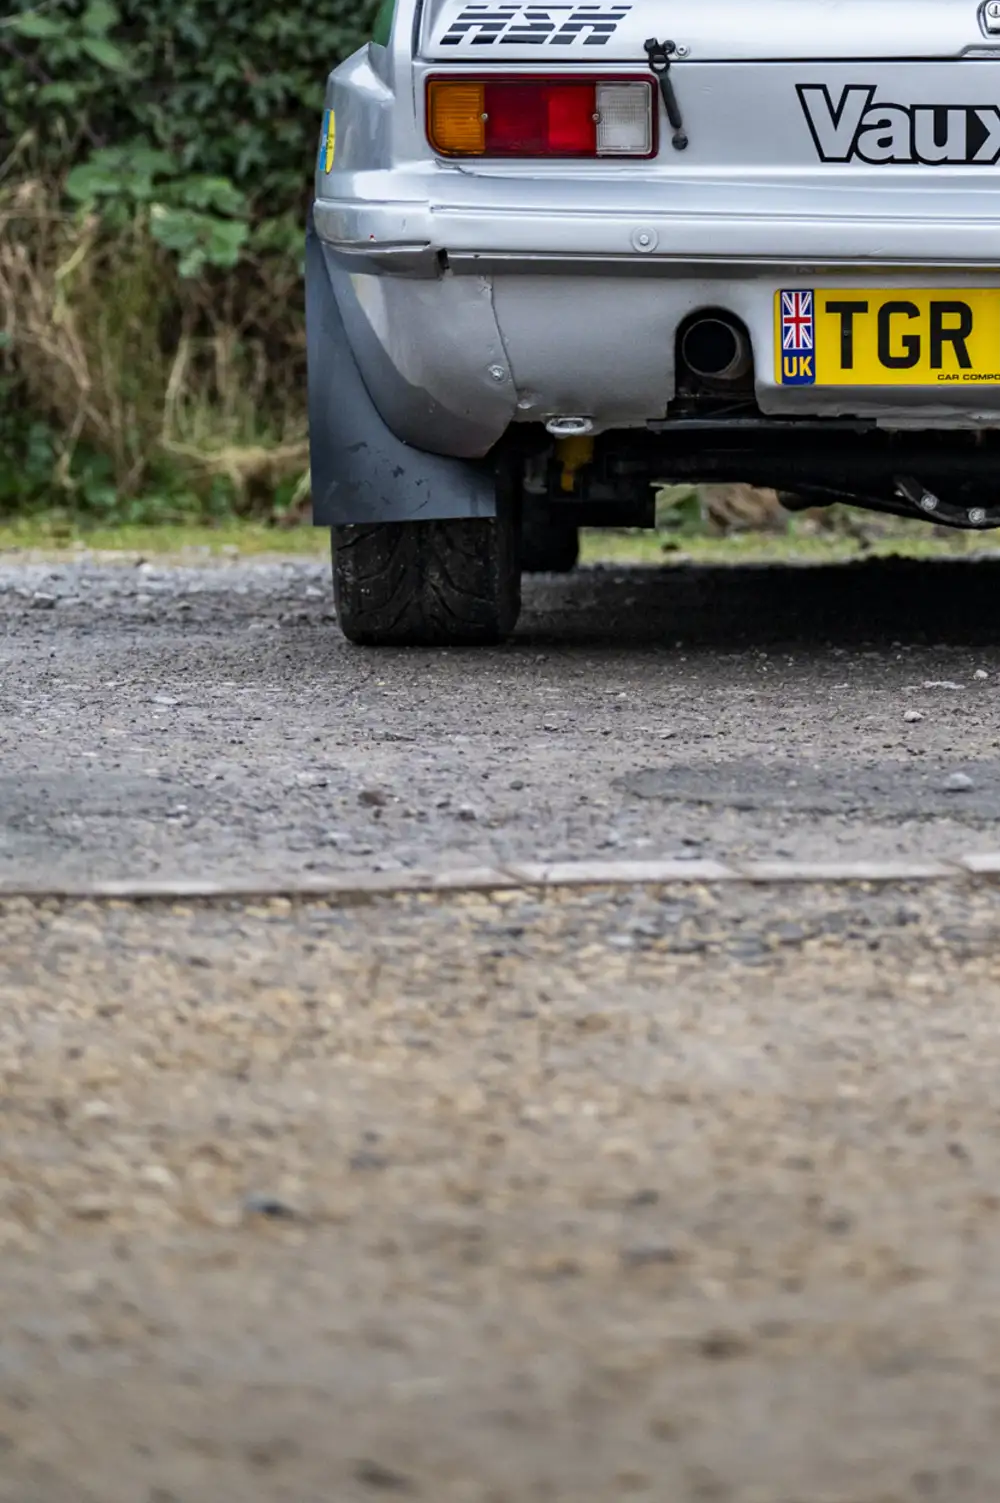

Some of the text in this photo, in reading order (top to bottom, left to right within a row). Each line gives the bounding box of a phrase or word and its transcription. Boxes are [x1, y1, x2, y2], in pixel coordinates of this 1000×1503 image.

[825, 300, 973, 369] TGR
[783, 356, 813, 377] UK
[937, 373, 960, 381] CAR
